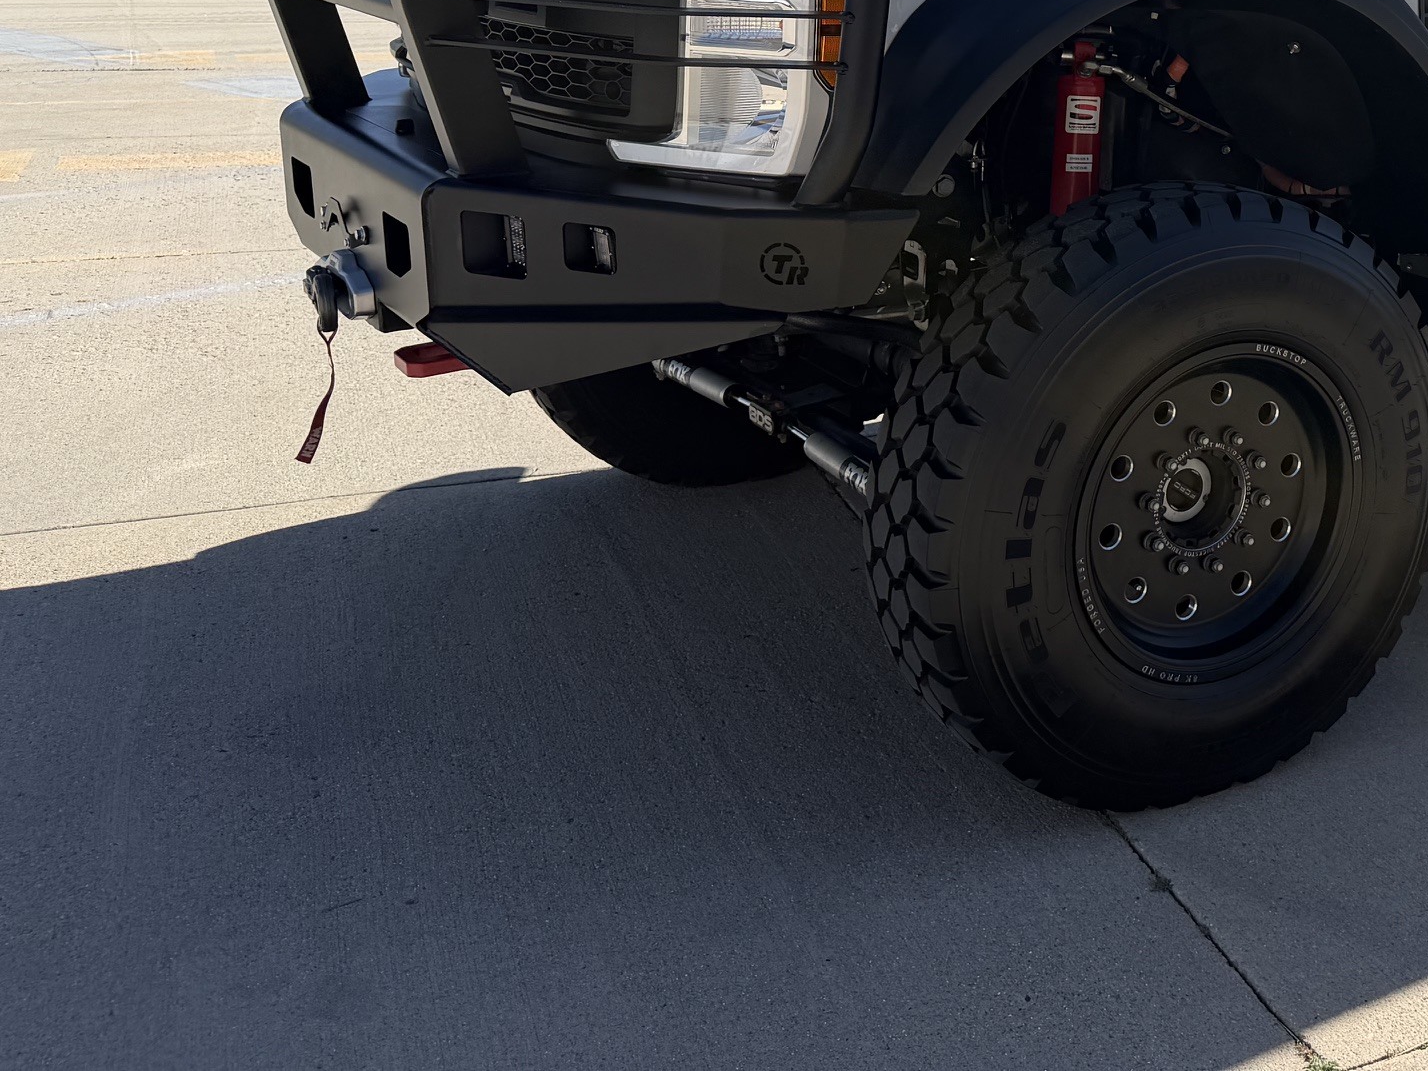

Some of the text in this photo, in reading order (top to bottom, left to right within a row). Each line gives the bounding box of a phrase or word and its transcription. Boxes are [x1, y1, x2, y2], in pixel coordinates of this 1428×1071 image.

[667, 359, 691, 385] FOX
[1255, 343, 1362, 461] BUCKSTOP TRUCKWARE
[1369, 329, 1423, 496] RM 910
[749, 407, 774, 433] BDS
[1076, 558, 1106, 634] FORGED USA
[1140, 664, 1156, 676] HD
[1159, 671, 1181, 683] PRO
